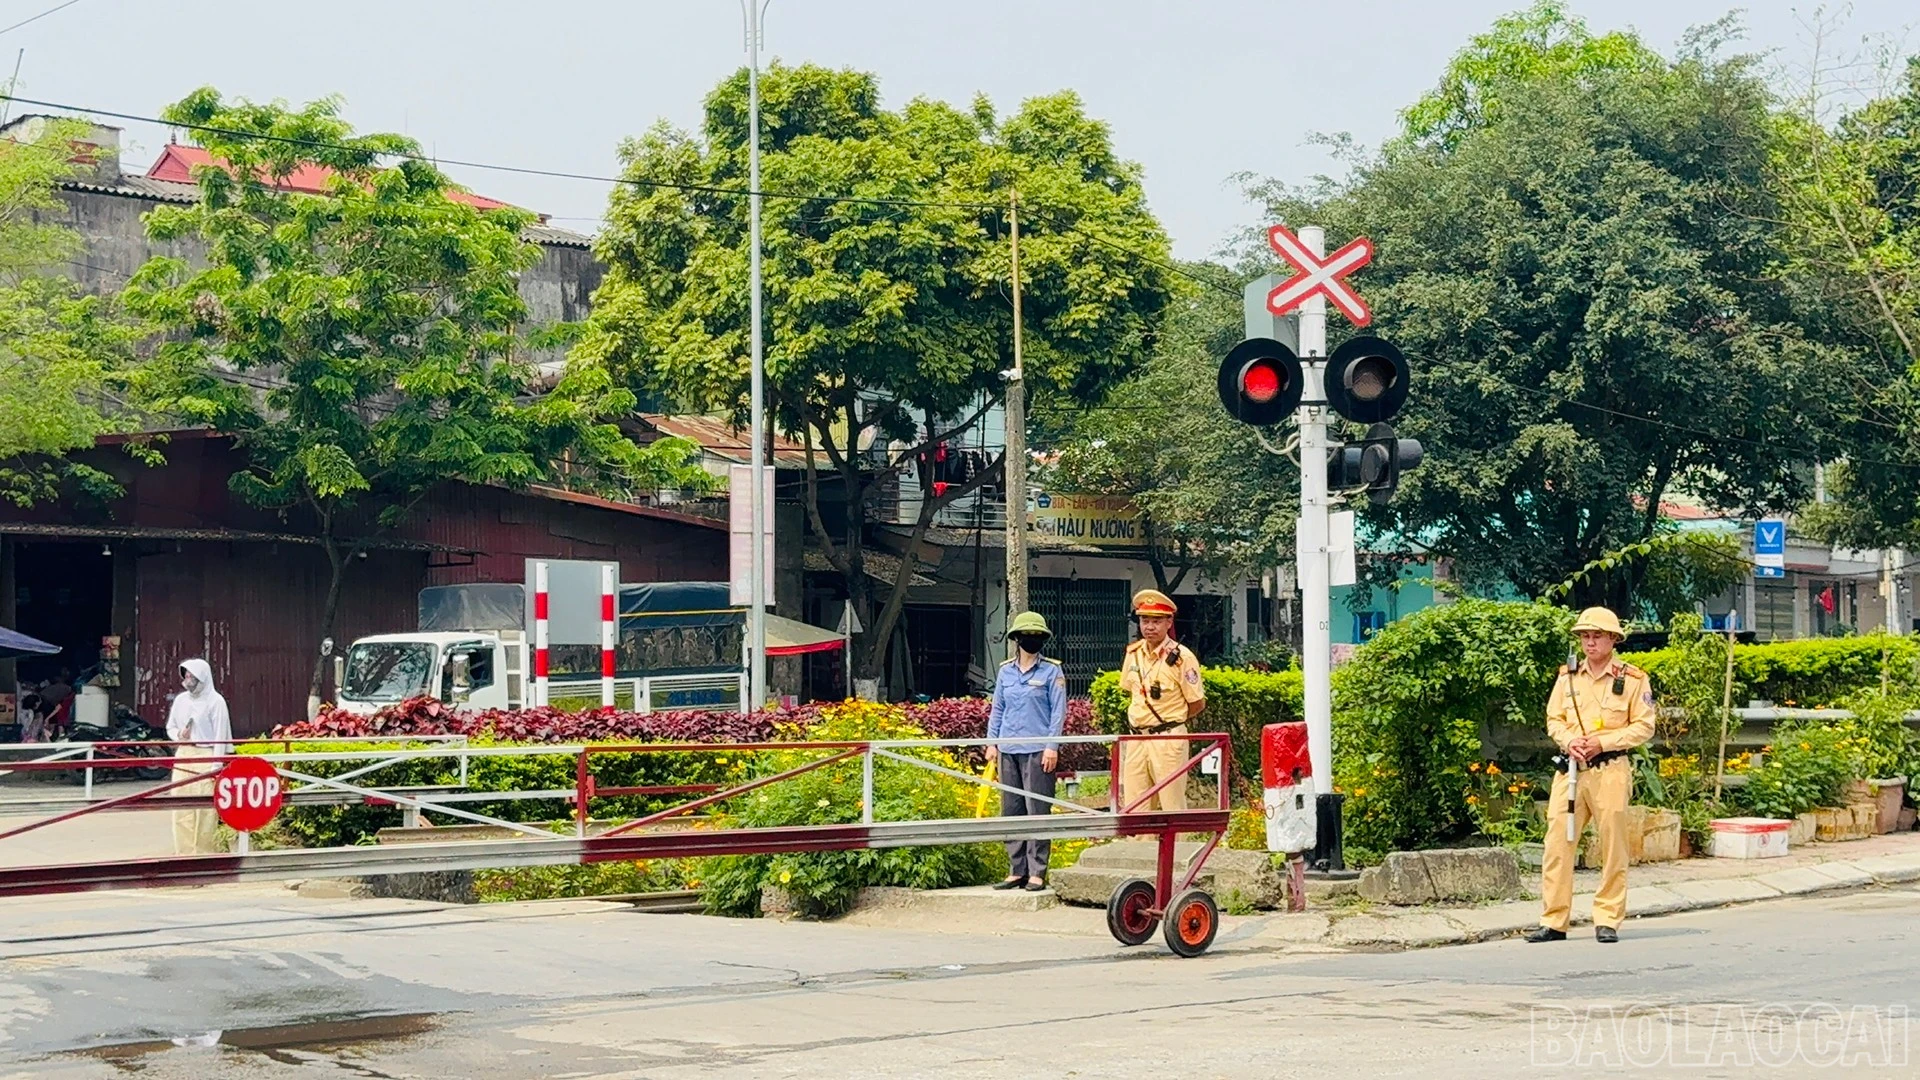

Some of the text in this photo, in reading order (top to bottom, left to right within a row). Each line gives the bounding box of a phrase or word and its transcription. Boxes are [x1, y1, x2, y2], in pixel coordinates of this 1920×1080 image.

[1057, 513, 1086, 537] HÀU
[1090, 515, 1135, 539] NƯỚNG
[218, 776, 280, 810] STOP
